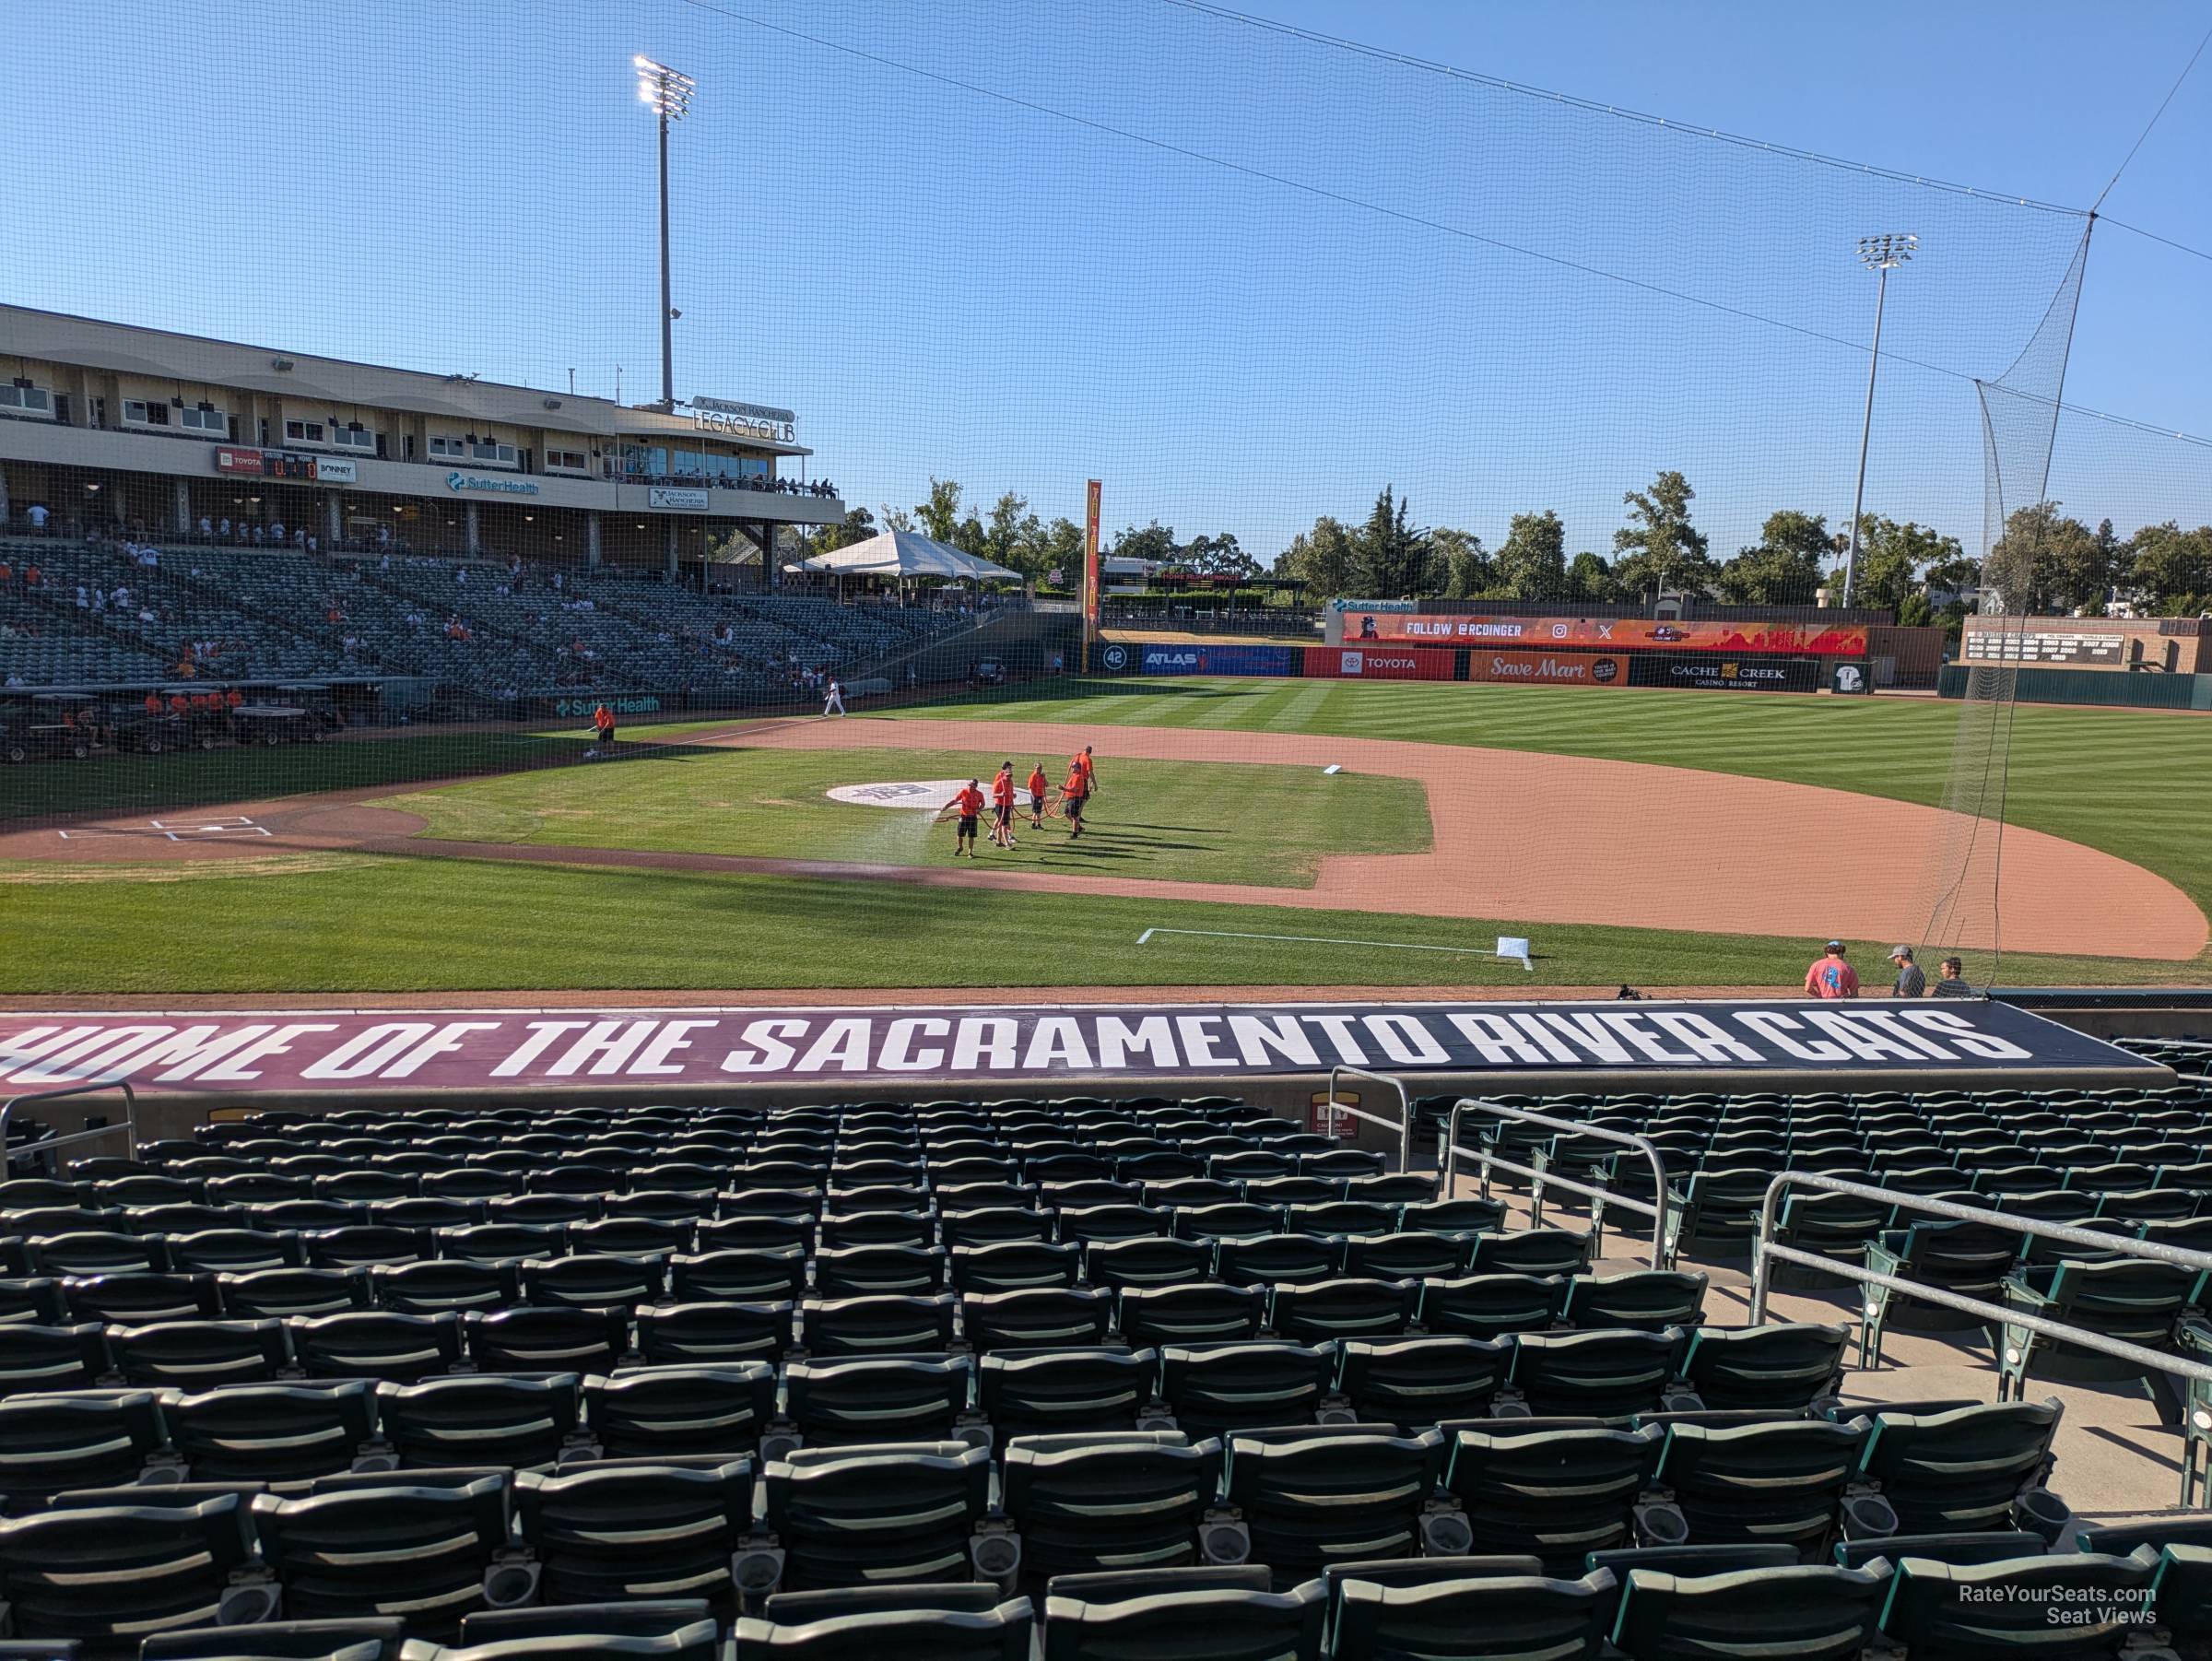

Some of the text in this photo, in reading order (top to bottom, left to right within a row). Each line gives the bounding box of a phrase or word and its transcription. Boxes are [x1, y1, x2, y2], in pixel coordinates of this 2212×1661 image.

[712, 400, 746, 414] JACKSON
[692, 410, 795, 442] LEGACY CLUB
[235, 457, 261, 465] TOYOTA
[321, 465, 352, 474] BONNEY
[1347, 601, 1413, 612] Sutter Health
[1406, 622, 1453, 635] FOLLOW
[1108, 651, 1122, 664] 42
[1146, 653, 1197, 666] ATLAS
[1367, 657, 1416, 669] TOYOTA
[1490, 656, 1585, 678] Save Mart
[1671, 666, 1785, 679] CACHE CREEK
[617, 696, 659, 713] Health
[0, 1009, 2033, 1083] HOME OF THE SACRAMENTO RIVER CATS
